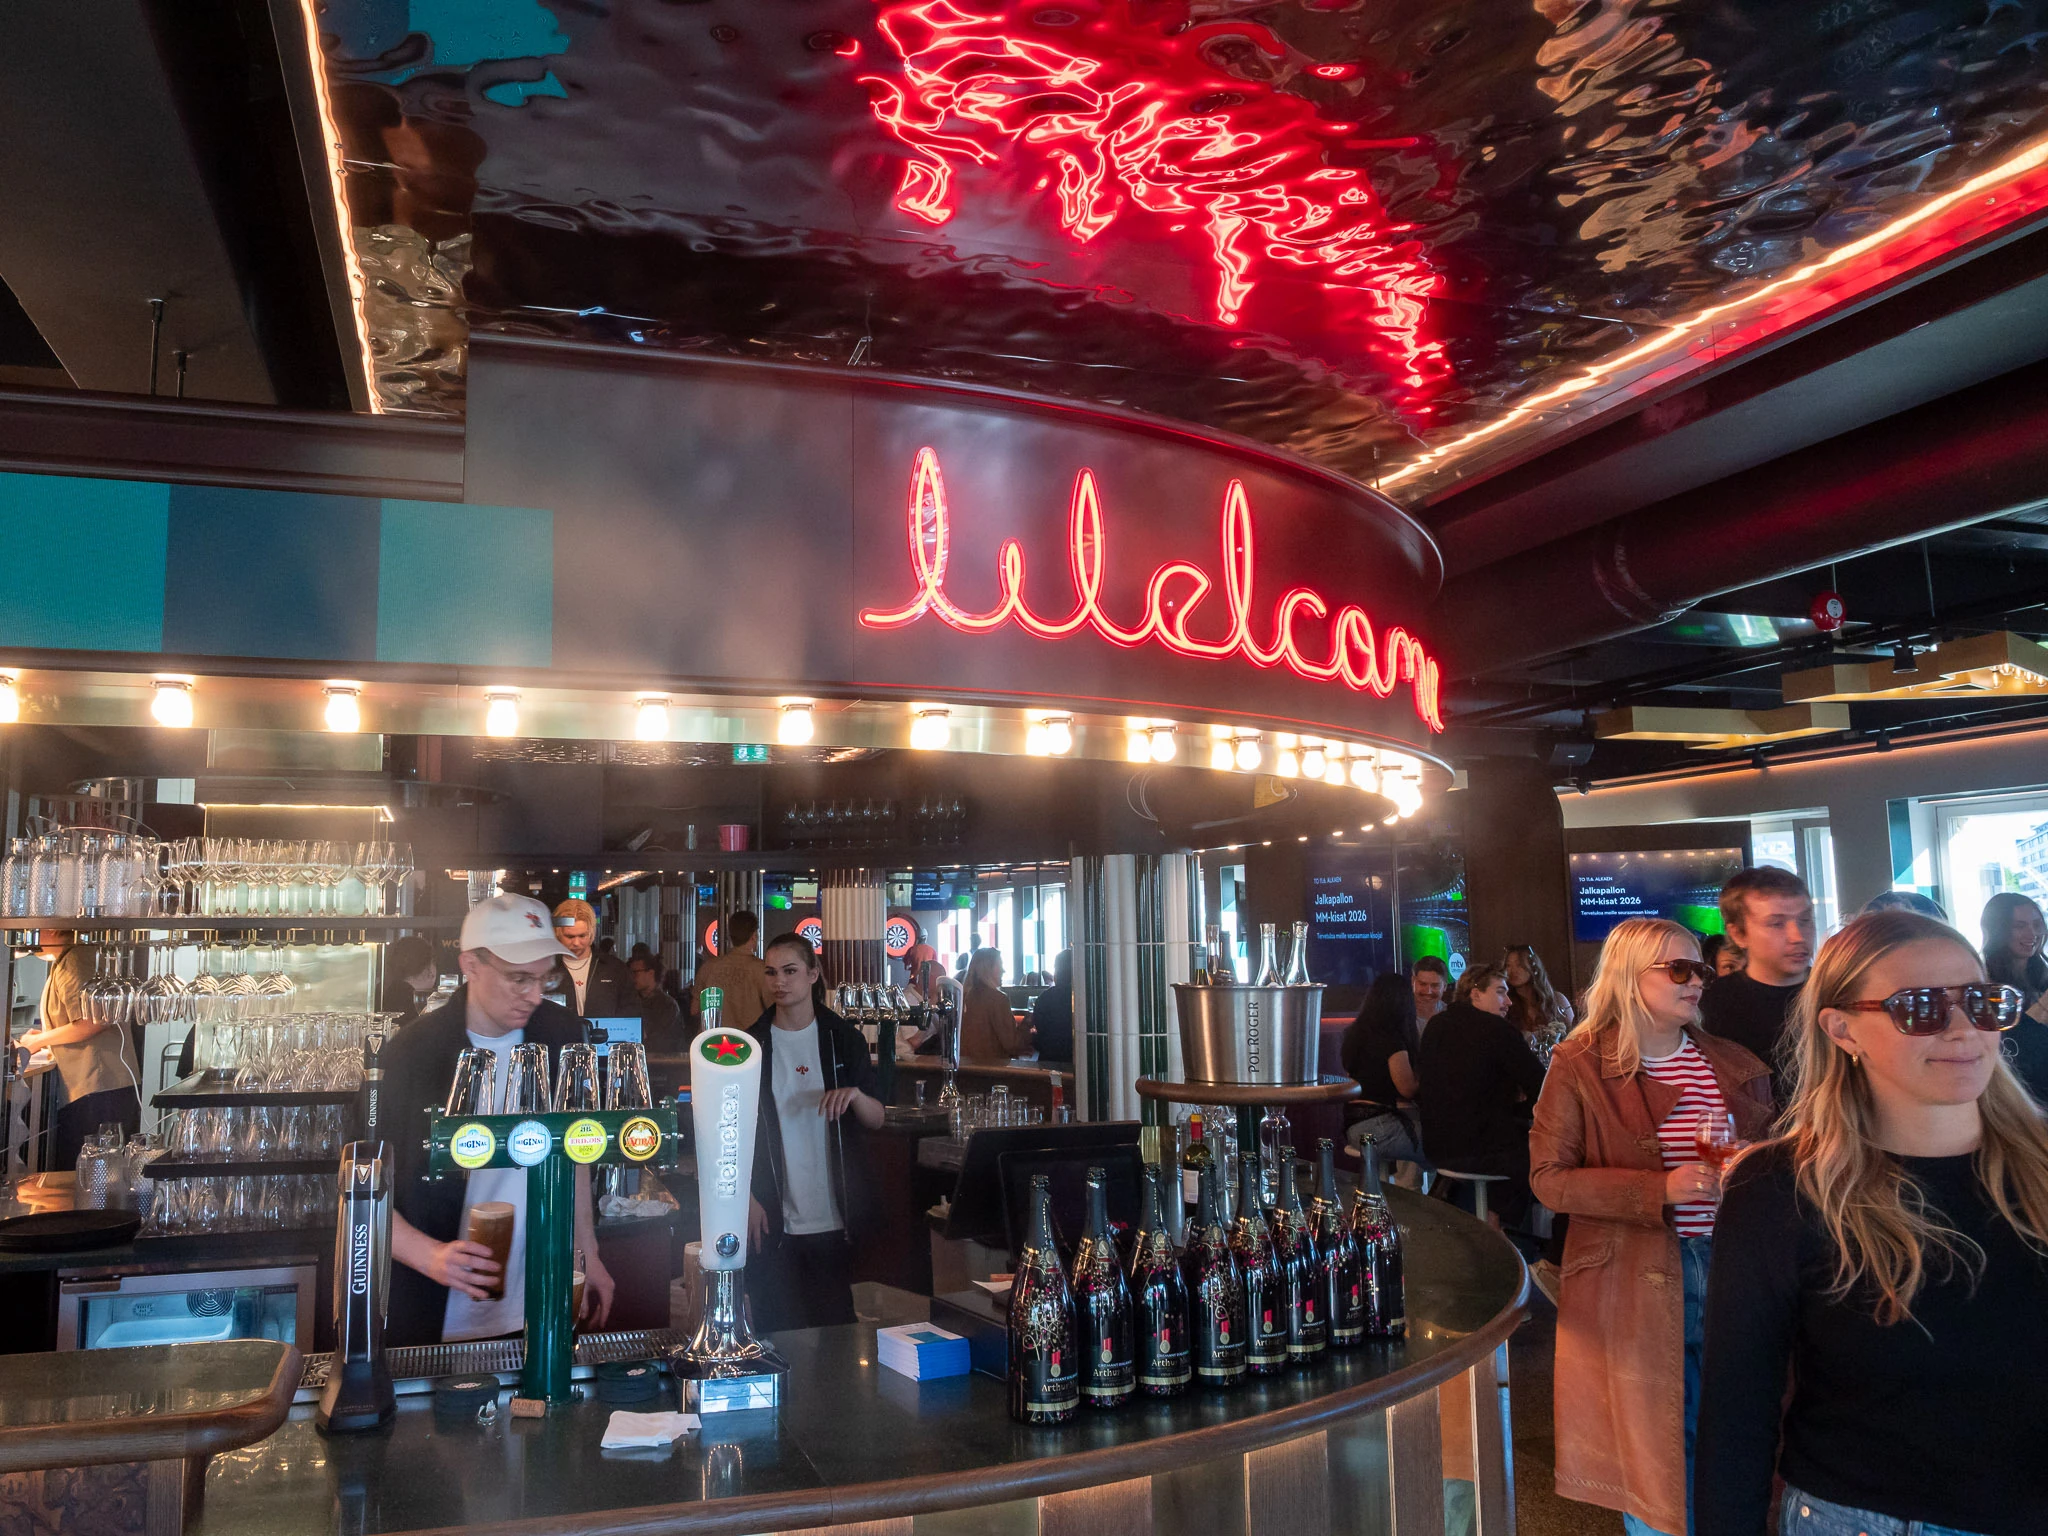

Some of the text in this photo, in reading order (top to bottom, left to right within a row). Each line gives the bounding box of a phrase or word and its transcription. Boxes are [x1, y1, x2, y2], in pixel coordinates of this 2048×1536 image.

[1580, 886, 1626, 895] Jalkapallon
[1315, 892, 1354, 907] Jalkapallon
[1581, 896, 1641, 905] MM-kisat 2026
[1316, 909, 1367, 923] MM-kisat 2026
[1451, 960, 1464, 969] mtv
[368, 1089, 378, 1127] GUINNESS
[718, 1083, 740, 1199] Heineken
[351, 1223, 368, 1294] GUINNESS
